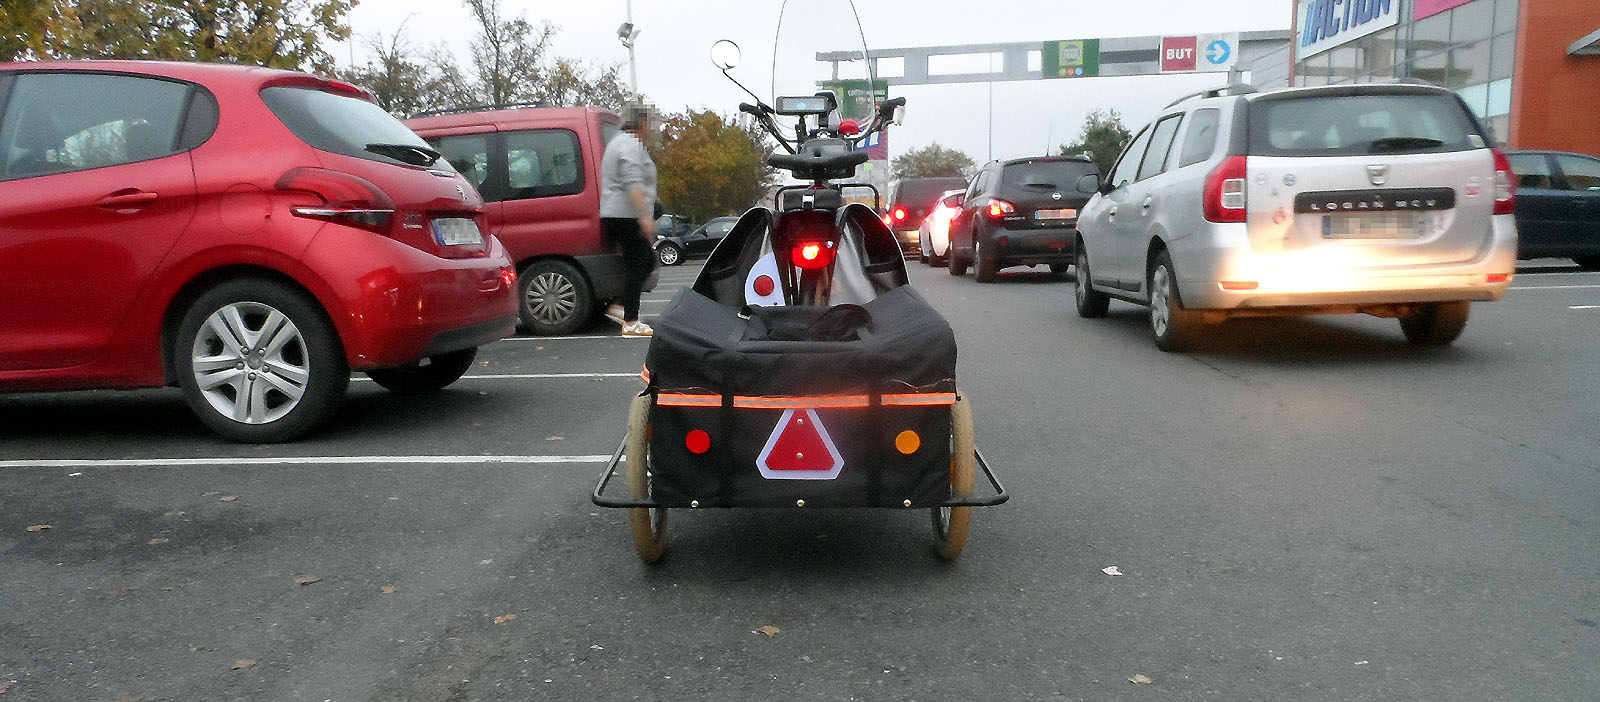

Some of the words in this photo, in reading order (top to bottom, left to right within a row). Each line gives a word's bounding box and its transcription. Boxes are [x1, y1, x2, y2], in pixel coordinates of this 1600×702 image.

[1166, 48, 1193, 60] BUT
[1310, 201, 1384, 211] LOGAN
[1395, 199, 1436, 208] MCV
